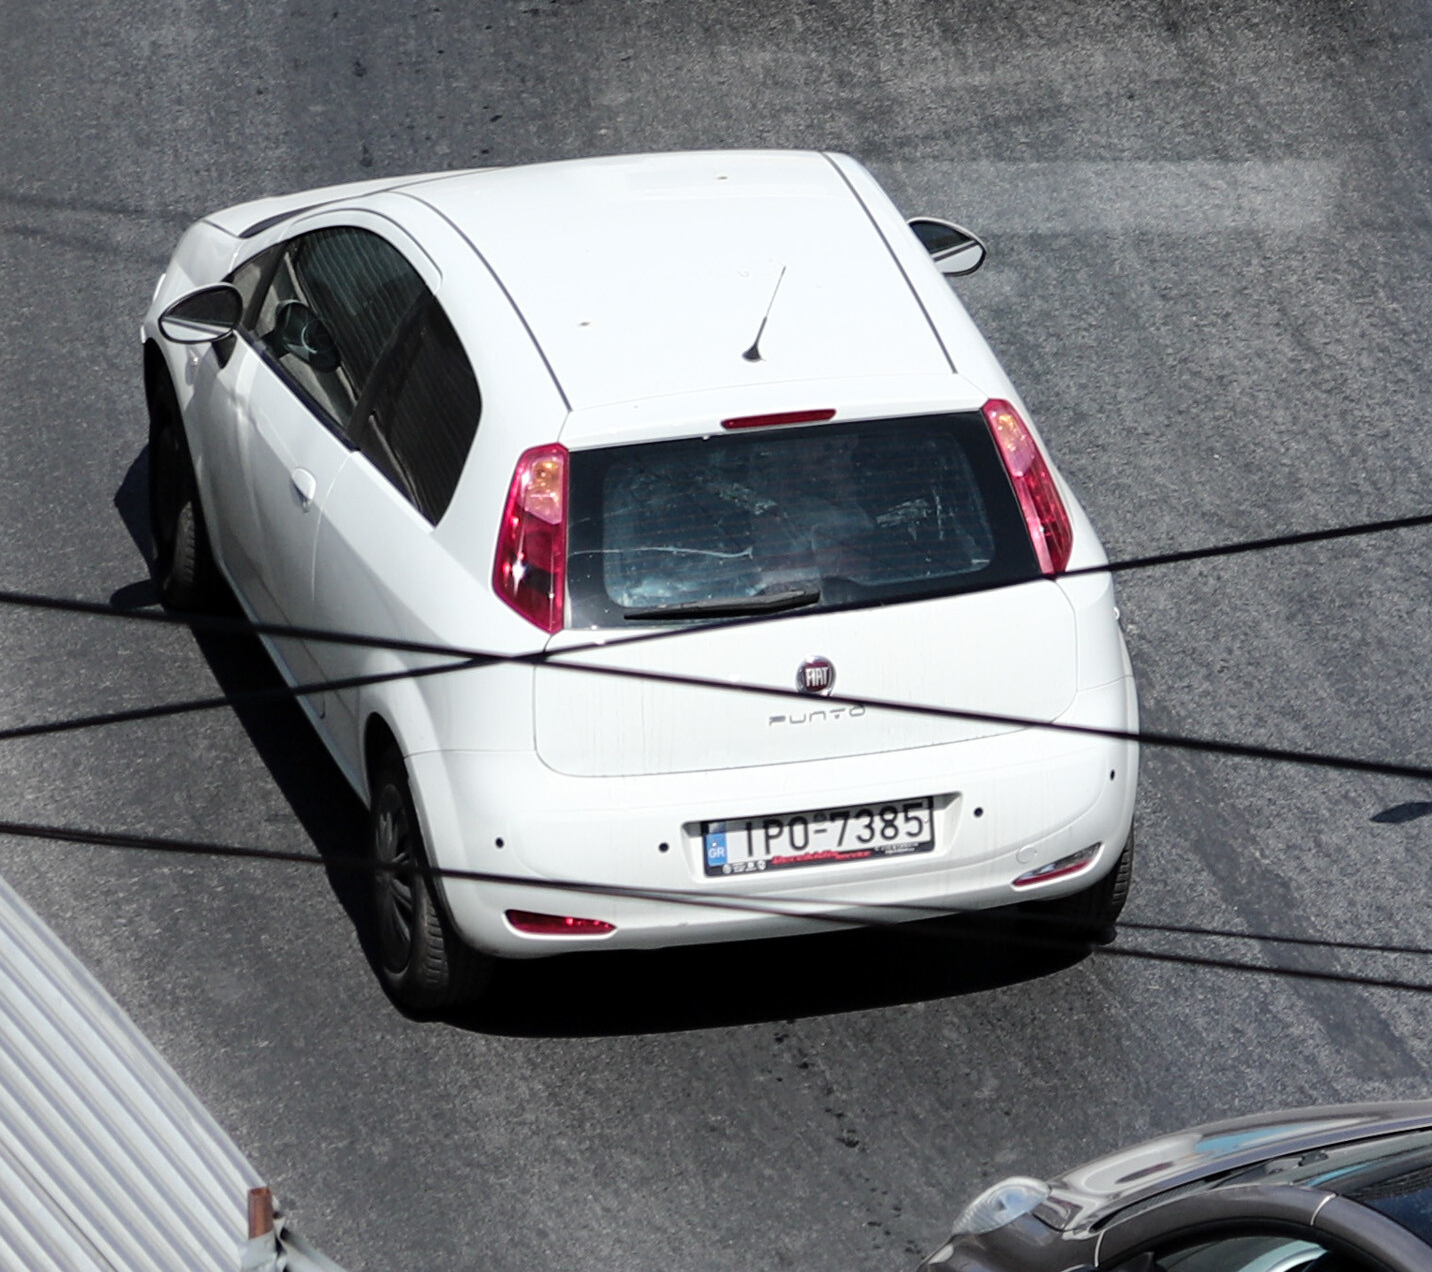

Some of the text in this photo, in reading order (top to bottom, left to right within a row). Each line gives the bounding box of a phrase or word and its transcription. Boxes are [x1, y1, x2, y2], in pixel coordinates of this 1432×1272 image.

[805, 667, 829, 687] FIAT
[769, 704, 866, 727] PUNTO
[746, 801, 923, 857] IPO-7385
